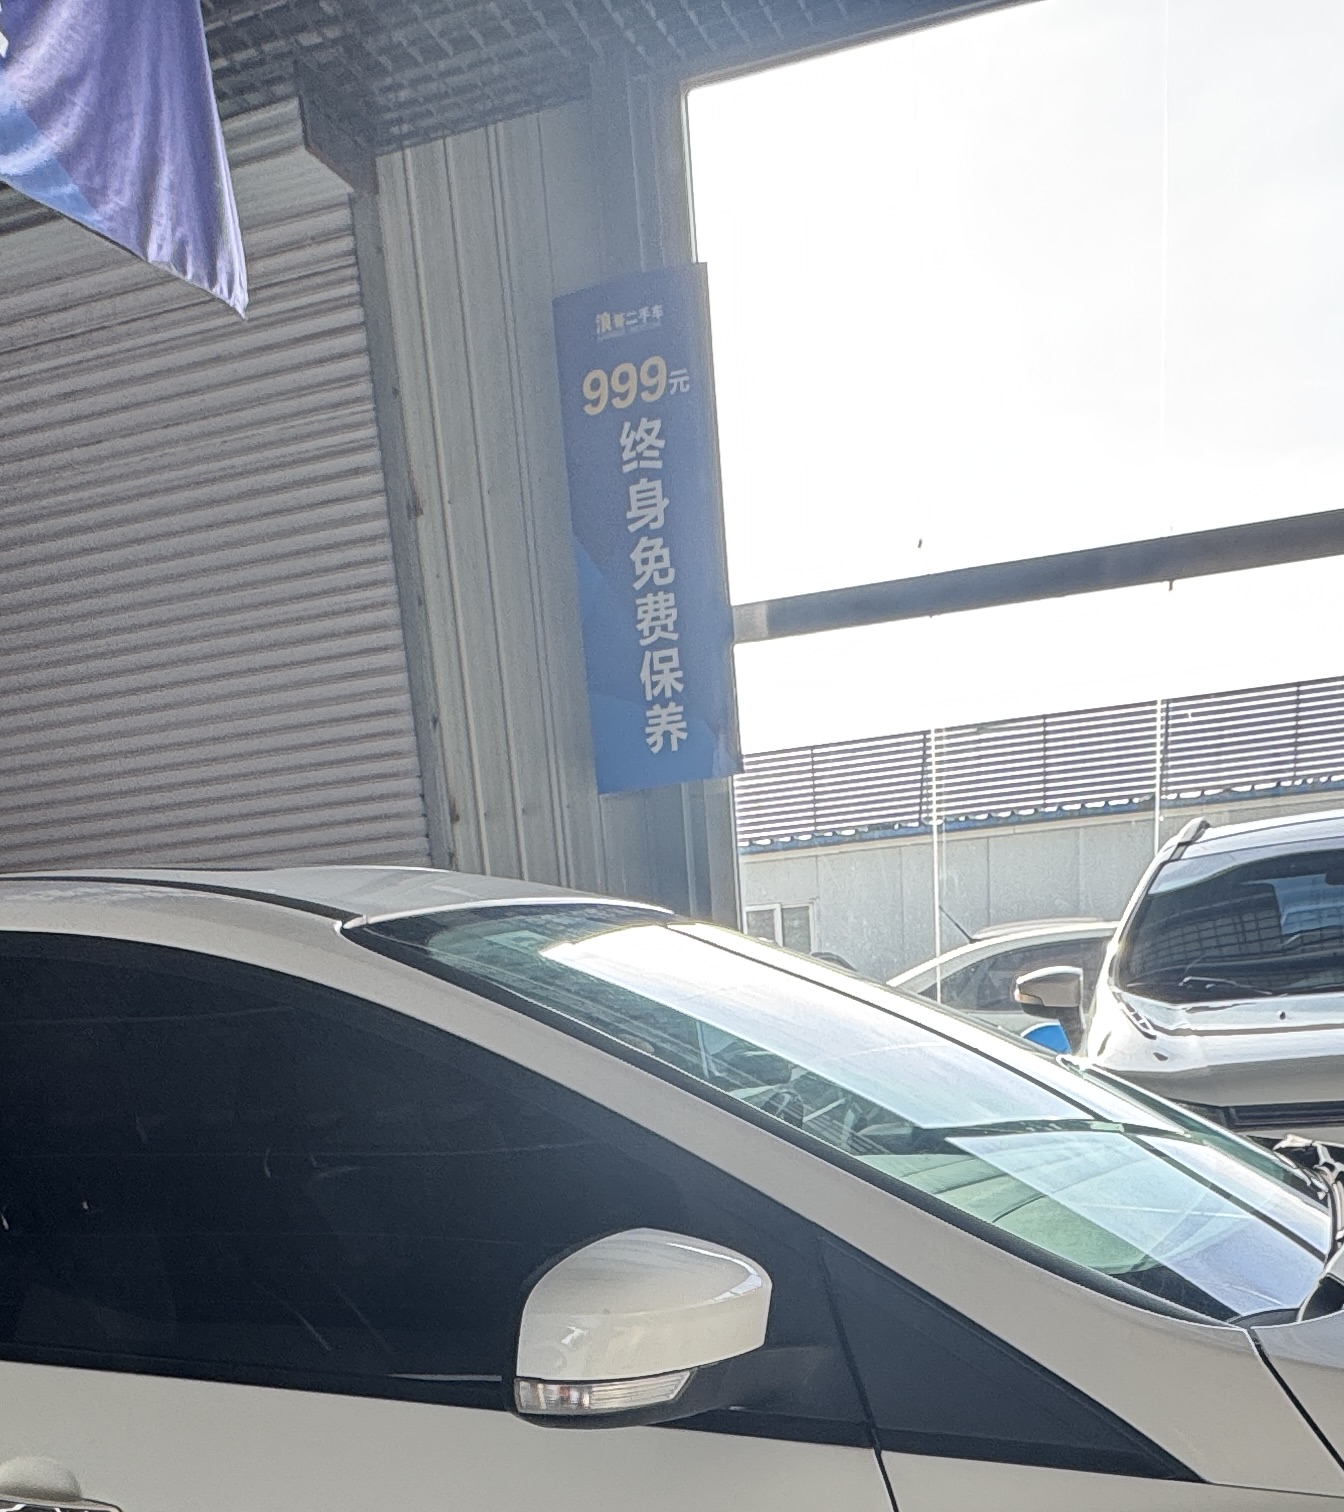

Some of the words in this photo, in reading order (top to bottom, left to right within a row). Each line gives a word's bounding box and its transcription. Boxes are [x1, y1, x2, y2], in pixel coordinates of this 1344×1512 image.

[582, 355, 690, 416] 999元
[619, 417, 689, 755] 终身免费保养
